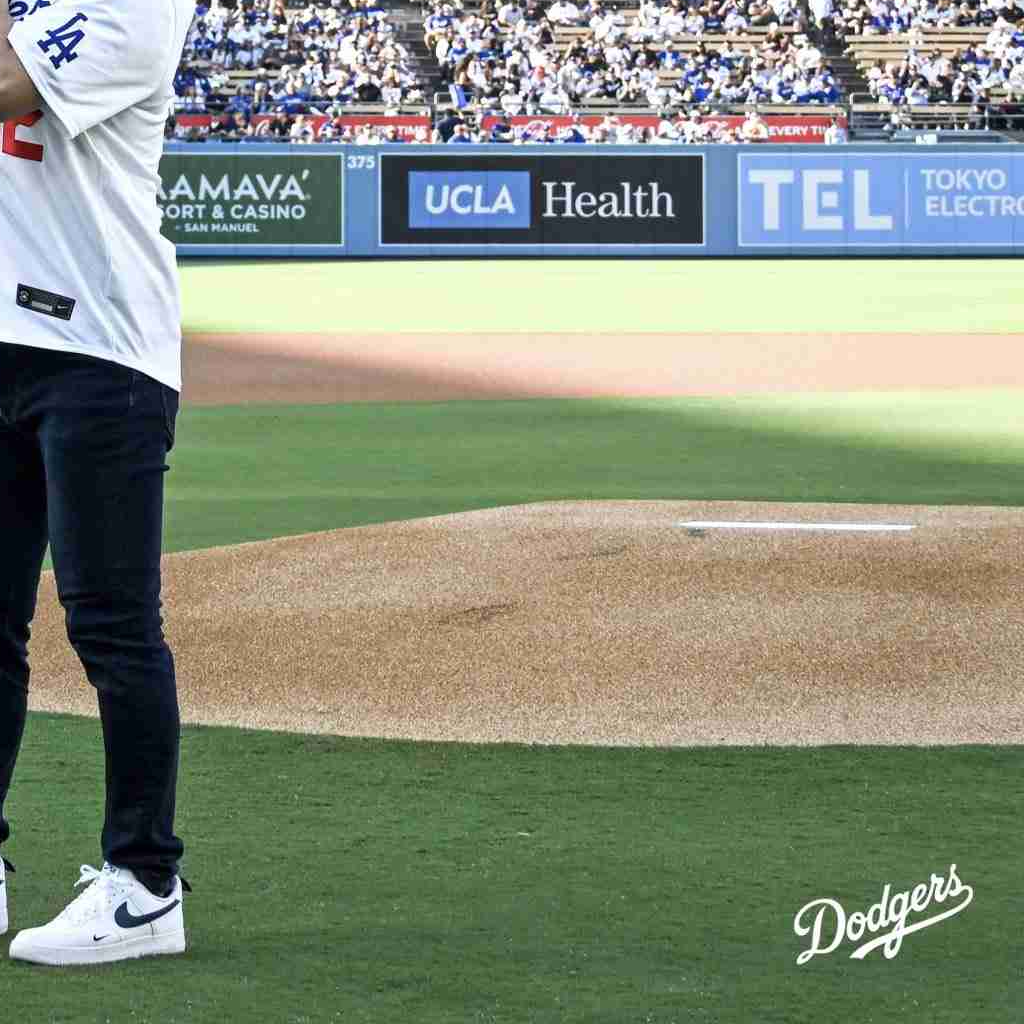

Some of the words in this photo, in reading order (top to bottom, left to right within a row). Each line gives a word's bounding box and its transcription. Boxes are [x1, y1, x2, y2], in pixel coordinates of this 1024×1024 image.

[37, 12, 88, 70] LA
[768, 125, 808, 137] EVERY
[346, 155, 376, 169] 375
[920, 169, 1006, 191] TOKYO
[426, 183, 515, 215] UCLA
[541, 181, 675, 218] Health
[748, 169, 893, 230] TEL
[211, 204, 225, 219] &
[230, 204, 306, 219] CASINO
[184, 222, 208, 232] SAN
[211, 222, 259, 233] MANUEL
